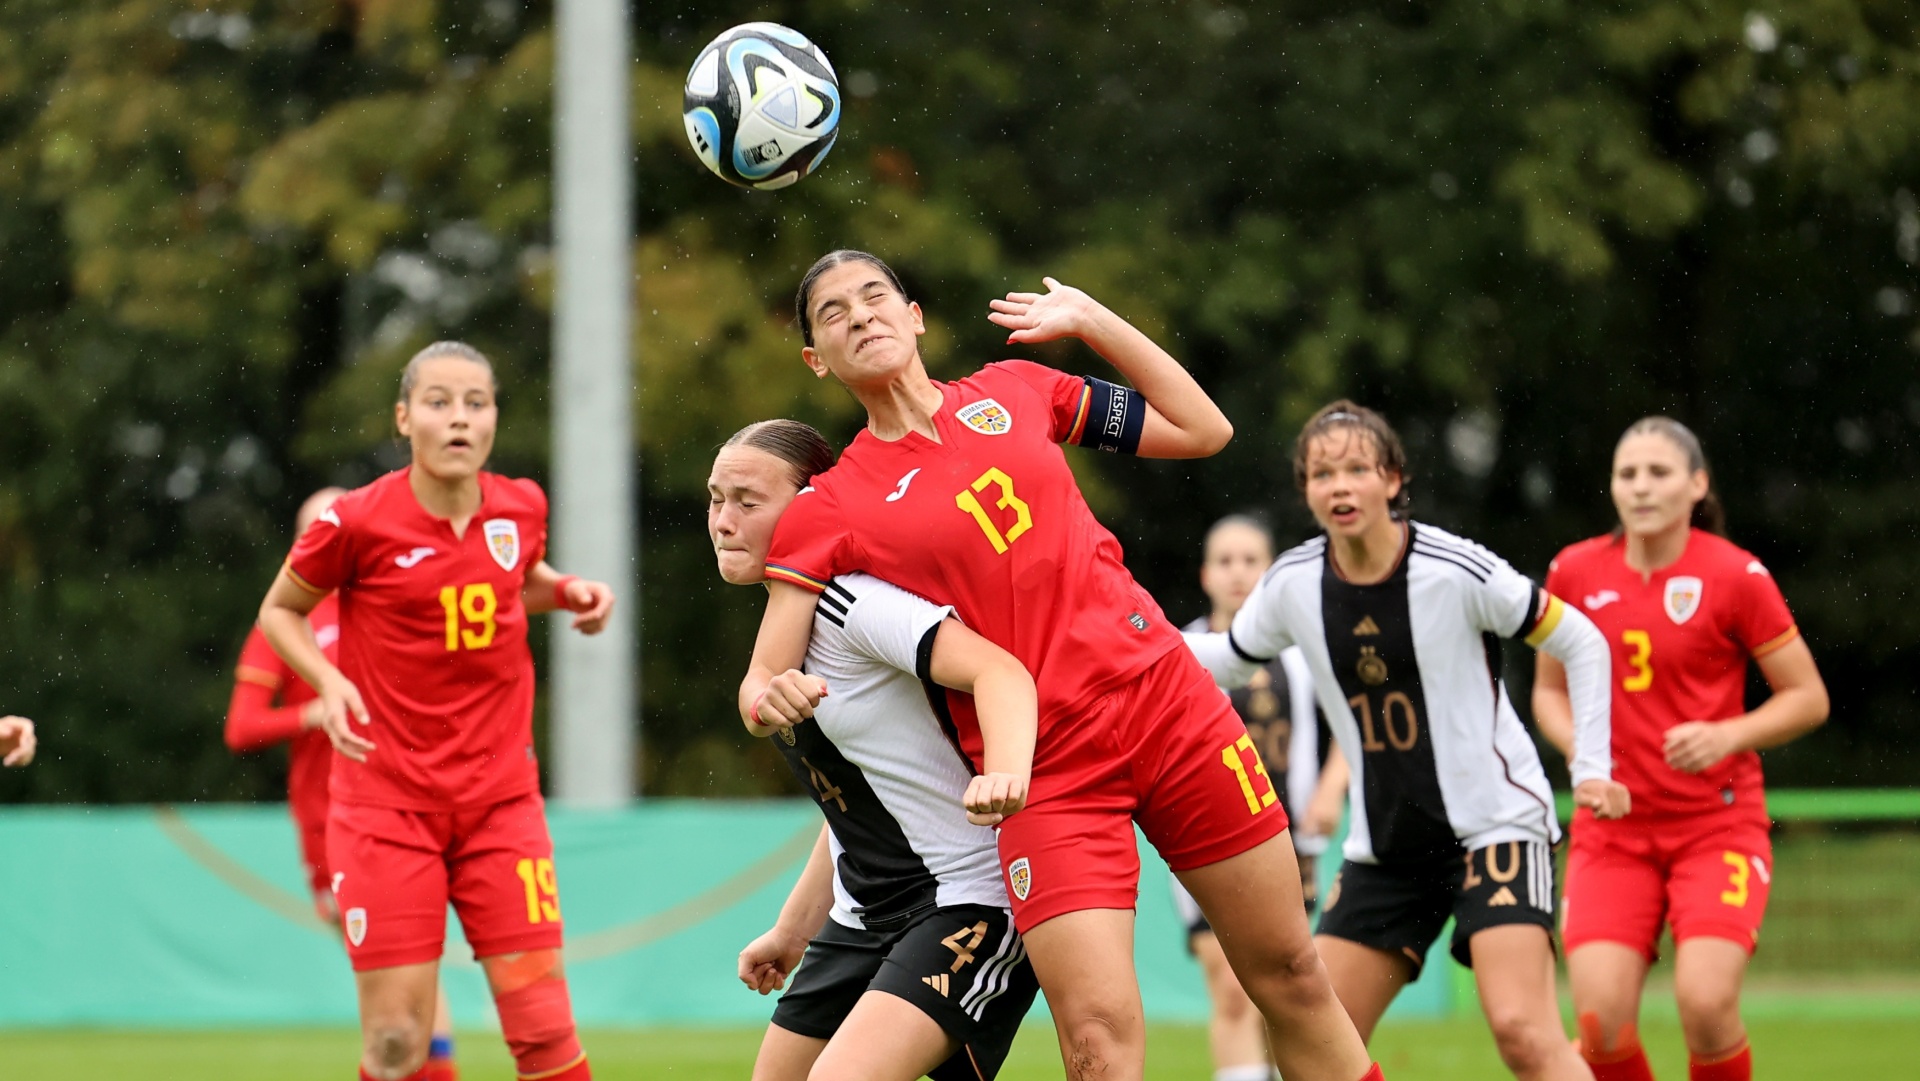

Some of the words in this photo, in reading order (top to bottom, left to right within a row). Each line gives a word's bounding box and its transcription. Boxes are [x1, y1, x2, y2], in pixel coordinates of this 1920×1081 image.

[1107, 389, 1125, 437] RESPECT
[955, 466, 1033, 555] 13
[438, 583, 498, 651] 19
[1622, 630, 1653, 692] 3
[1349, 691, 1419, 752] 10
[801, 756, 848, 812] 4
[1222, 733, 1277, 815] 13
[516, 858, 560, 924] 19
[1463, 840, 1520, 891] 10
[1720, 850, 1749, 907] 3
[940, 920, 989, 974] 4
